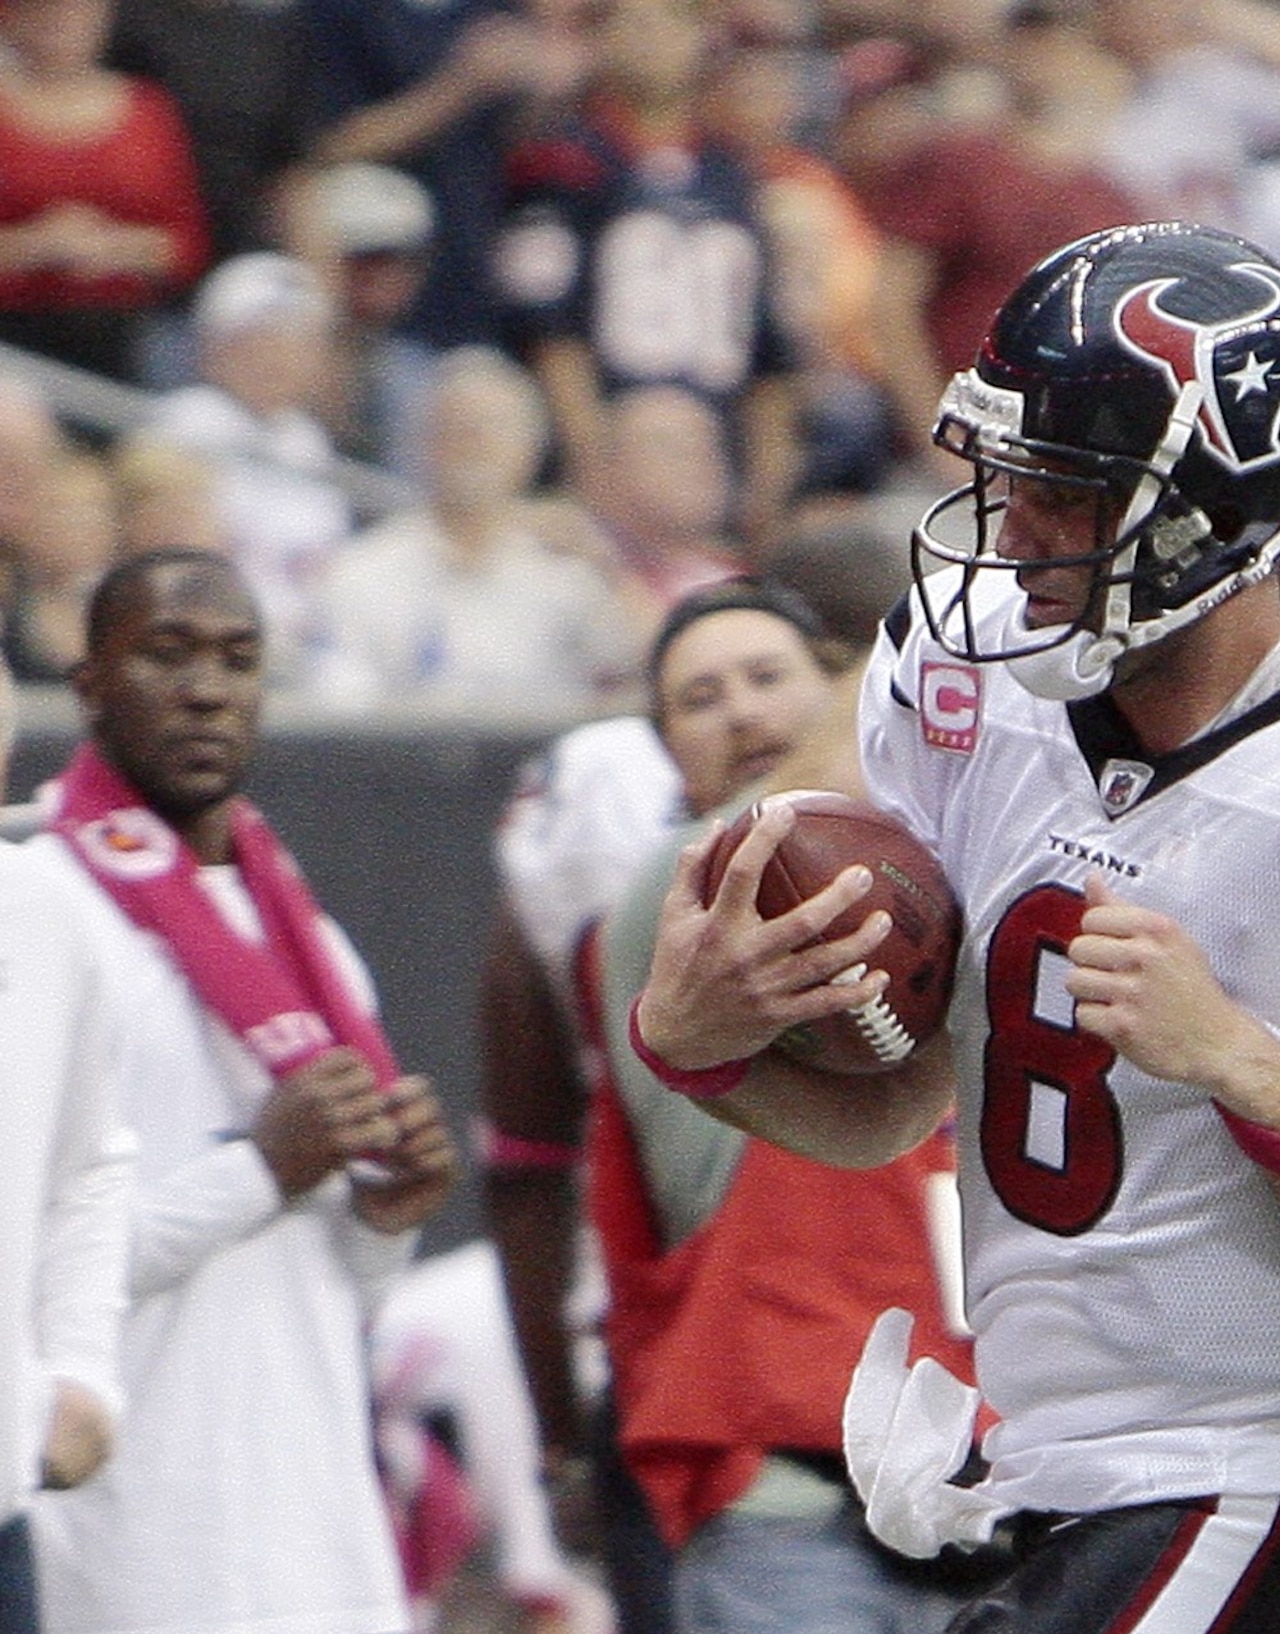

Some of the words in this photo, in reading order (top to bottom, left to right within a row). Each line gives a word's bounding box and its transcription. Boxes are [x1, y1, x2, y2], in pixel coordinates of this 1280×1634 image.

[922, 667, 978, 732] C
[1047, 832, 1142, 878] TEXANS
[978, 880, 1126, 1238] 8
